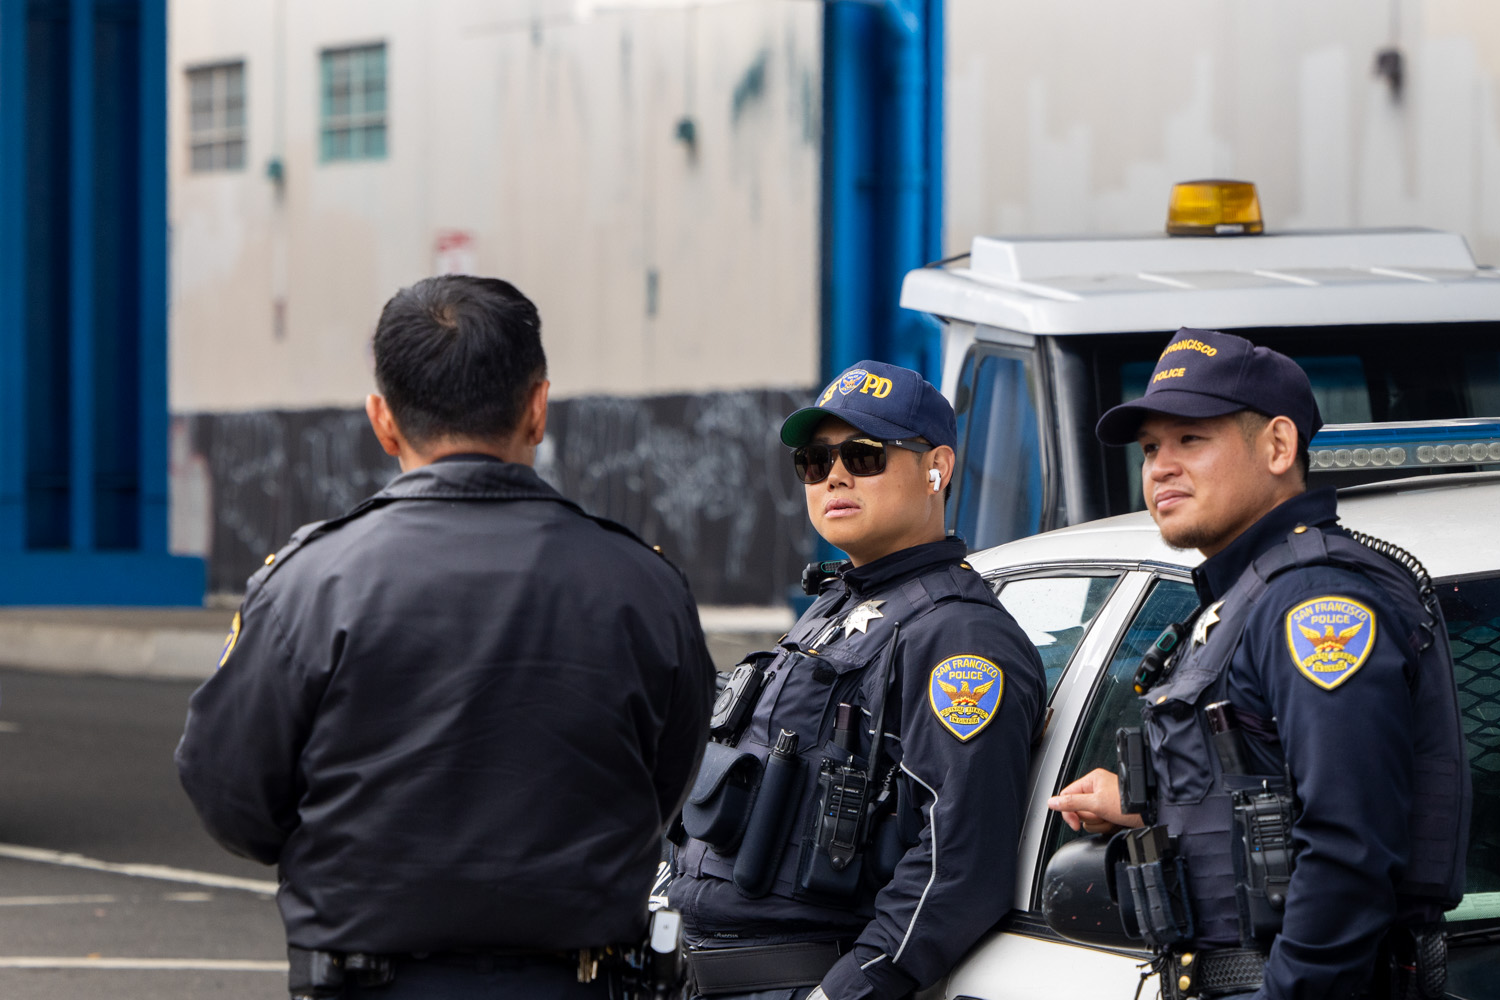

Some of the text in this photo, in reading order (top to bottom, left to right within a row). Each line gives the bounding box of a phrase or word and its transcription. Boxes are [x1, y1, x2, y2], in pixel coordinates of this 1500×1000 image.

[1165, 339, 1218, 357] FRANCISCO
[1152, 367, 1187, 384] POLICE
[859, 372, 893, 399] PD
[1293, 602, 1369, 624] SAN FRANCISCO
[1311, 614, 1351, 624] POLICE
[934, 658, 998, 679] SAN FRANCISCO
[948, 671, 984, 680] POLICE
